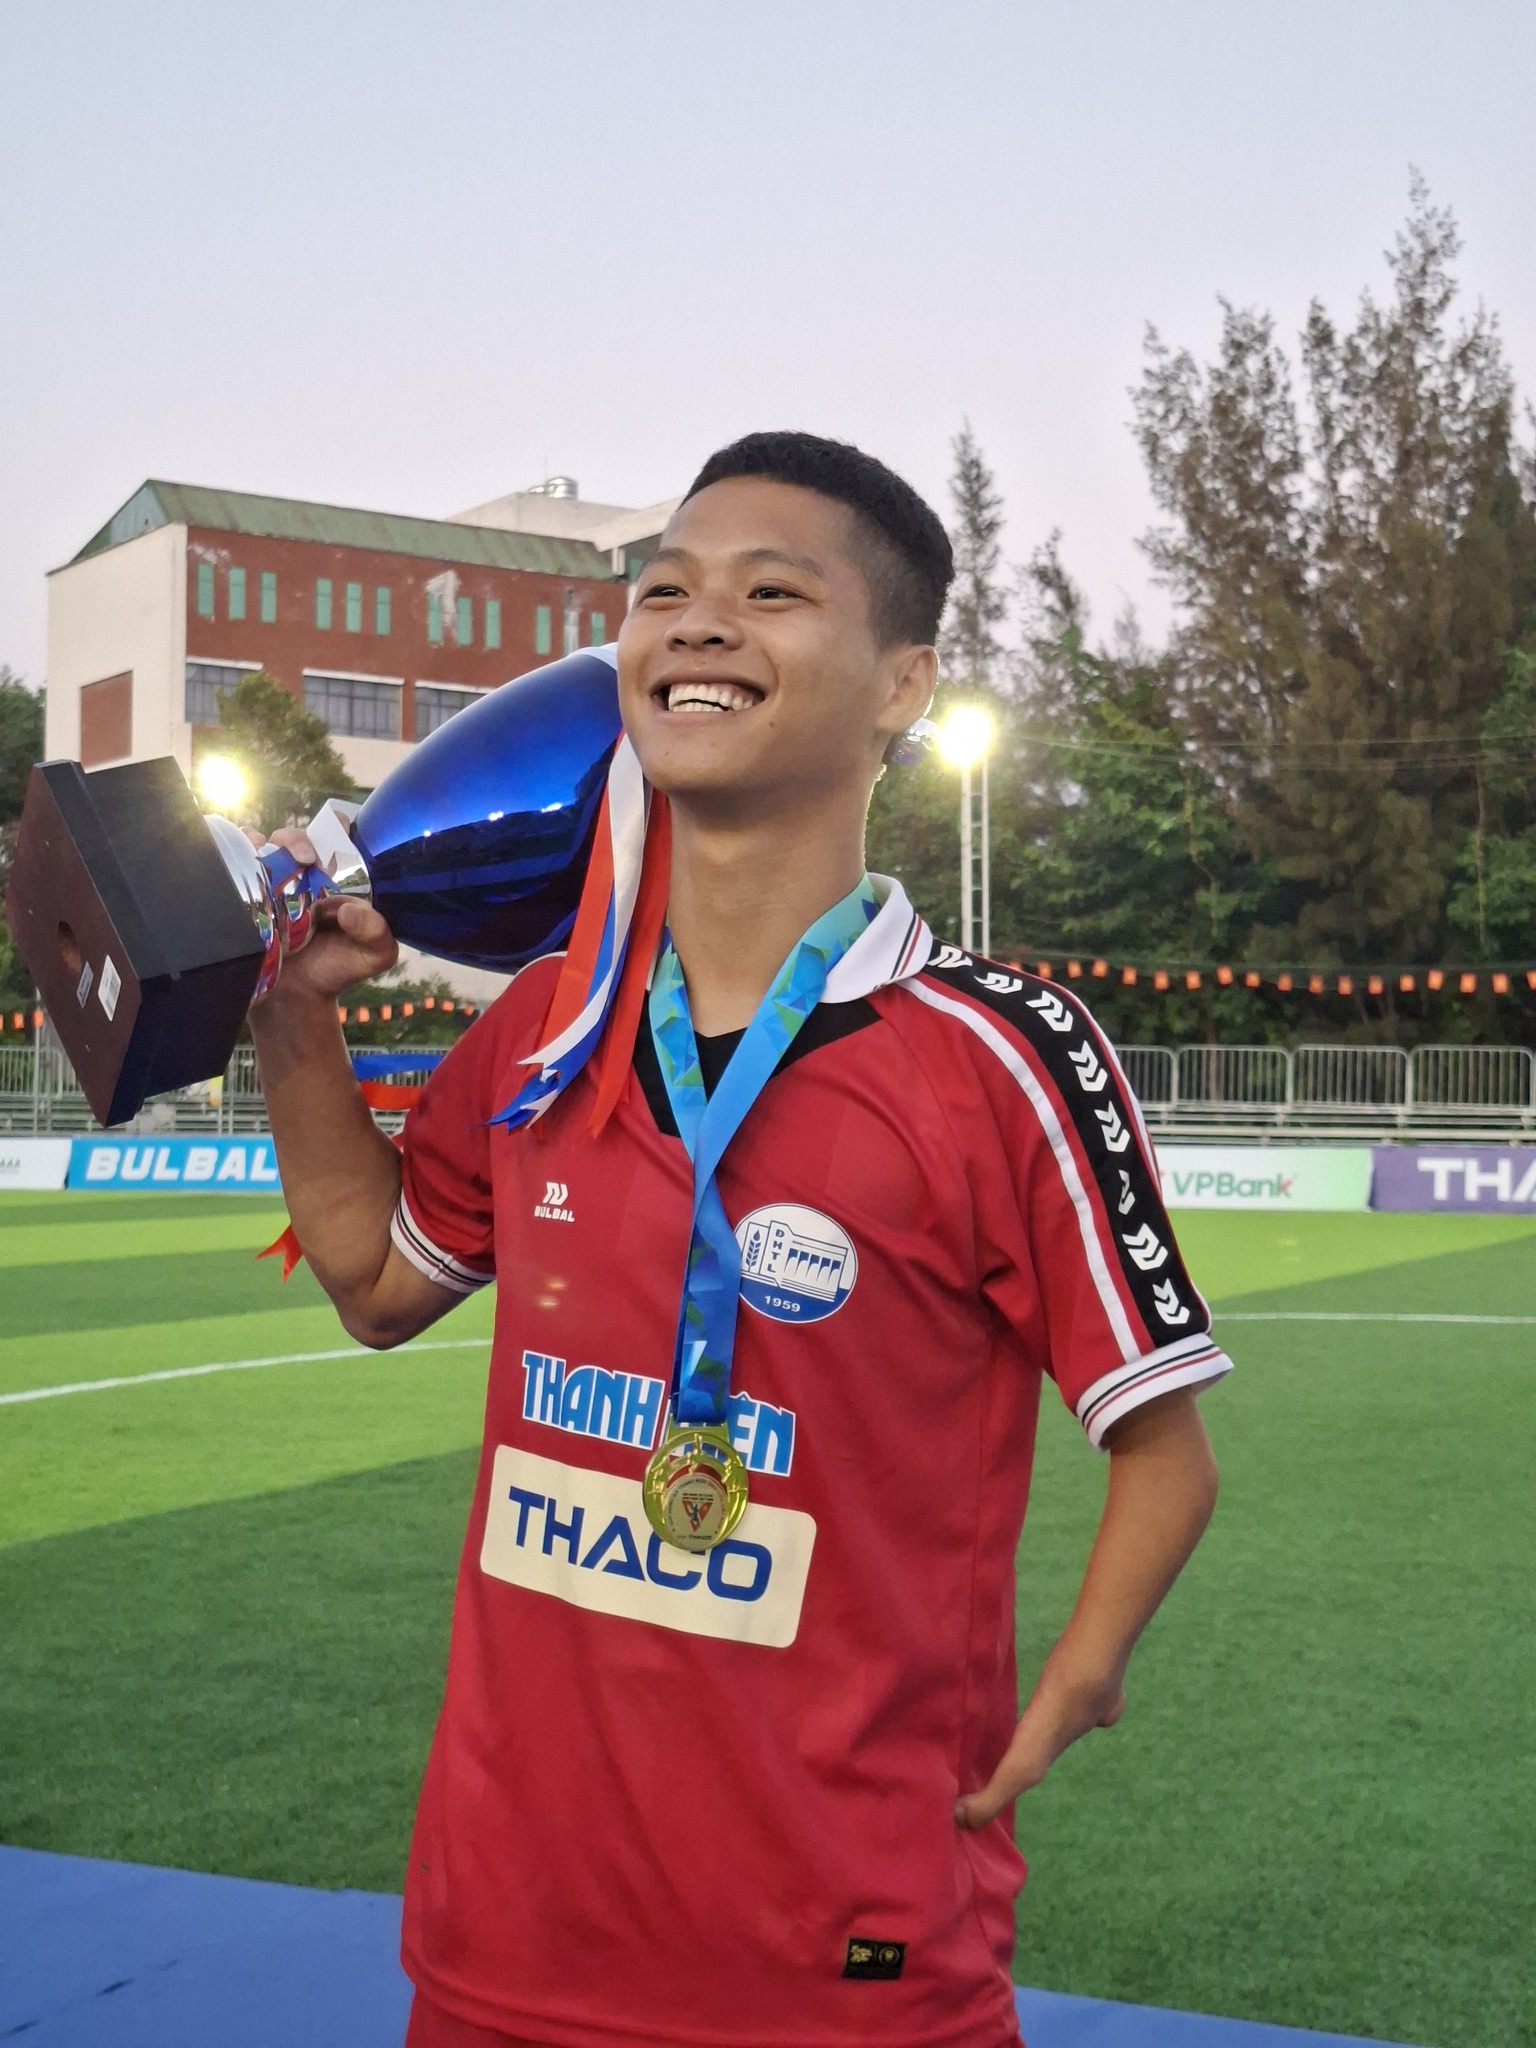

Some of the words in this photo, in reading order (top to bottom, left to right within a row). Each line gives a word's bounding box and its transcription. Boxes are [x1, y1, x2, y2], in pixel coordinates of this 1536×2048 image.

[86, 1147, 279, 1181] BULBAL
[1173, 1171, 1293, 1198] VPBank
[764, 1295, 801, 1313] 1959
[522, 1350, 666, 1450] THANH
[508, 1485, 773, 1602] THACO
